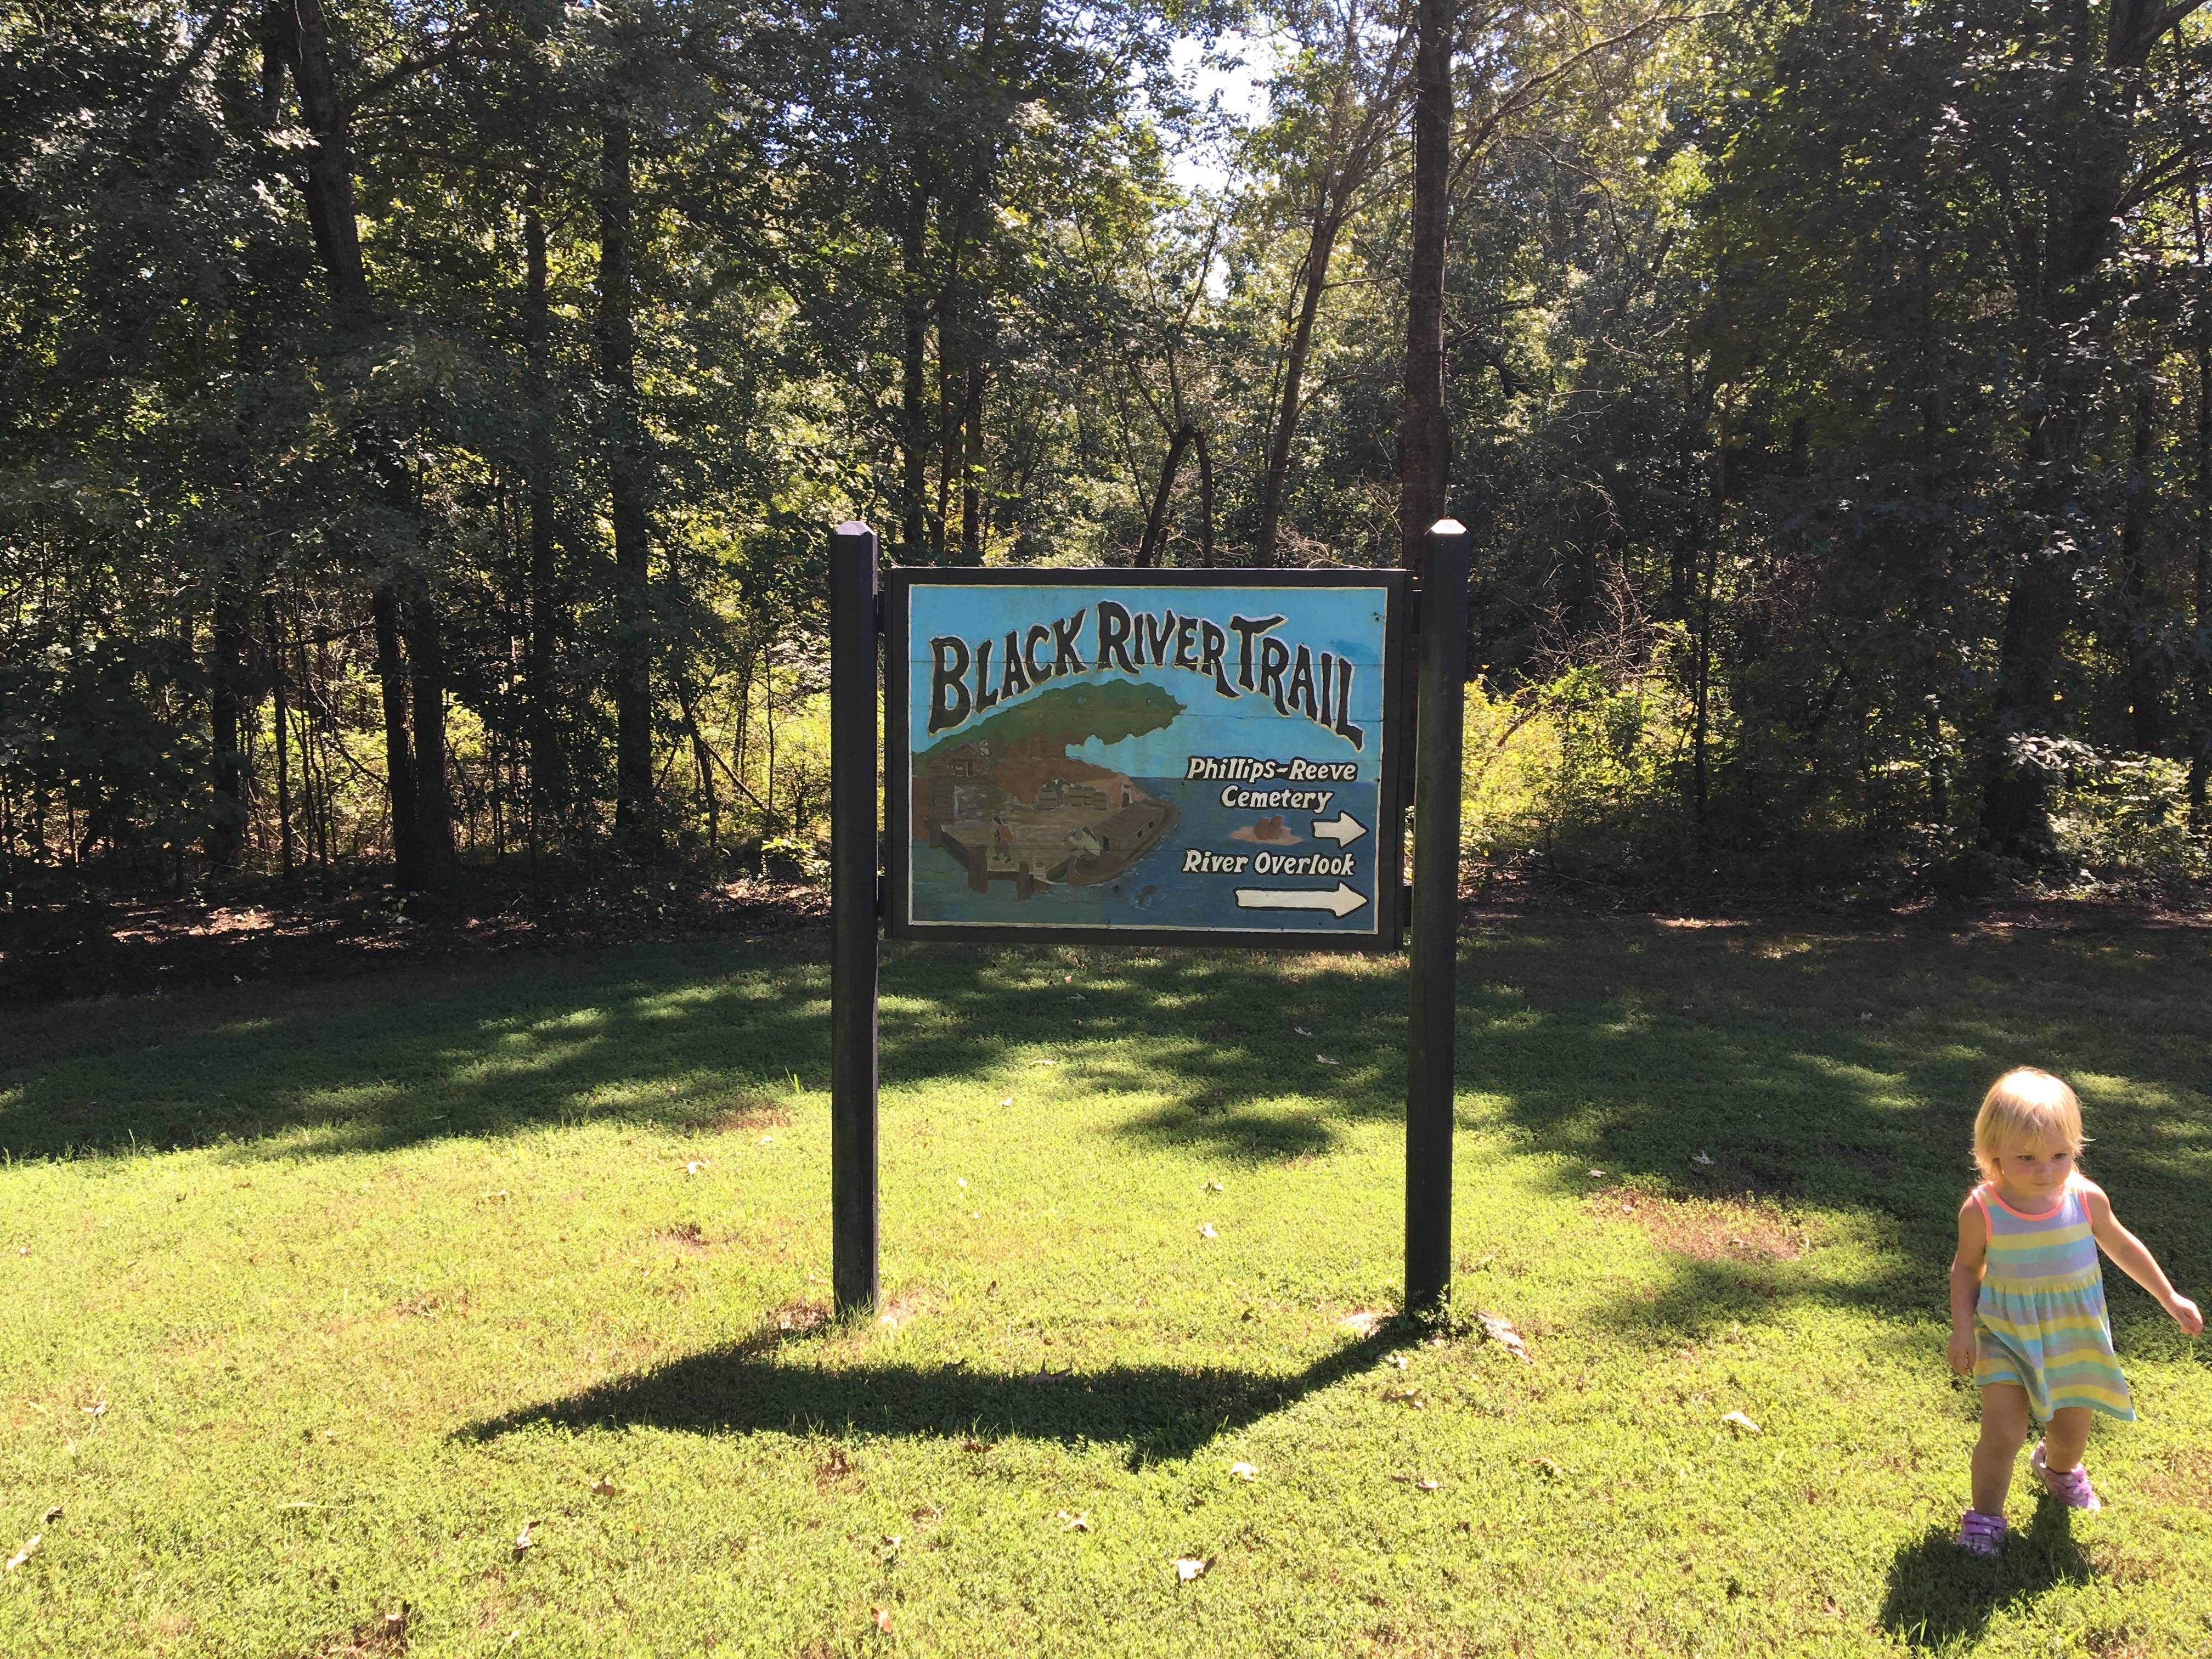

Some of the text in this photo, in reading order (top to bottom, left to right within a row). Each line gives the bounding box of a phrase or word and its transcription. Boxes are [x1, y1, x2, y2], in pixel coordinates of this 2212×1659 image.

[928, 600, 1364, 752] BLACK RIVER TRAIL
[1187, 758, 1356, 783] Phillips-Reeve
[1221, 785, 1333, 814] Cemetery
[1183, 850, 1354, 876] River Overlook
